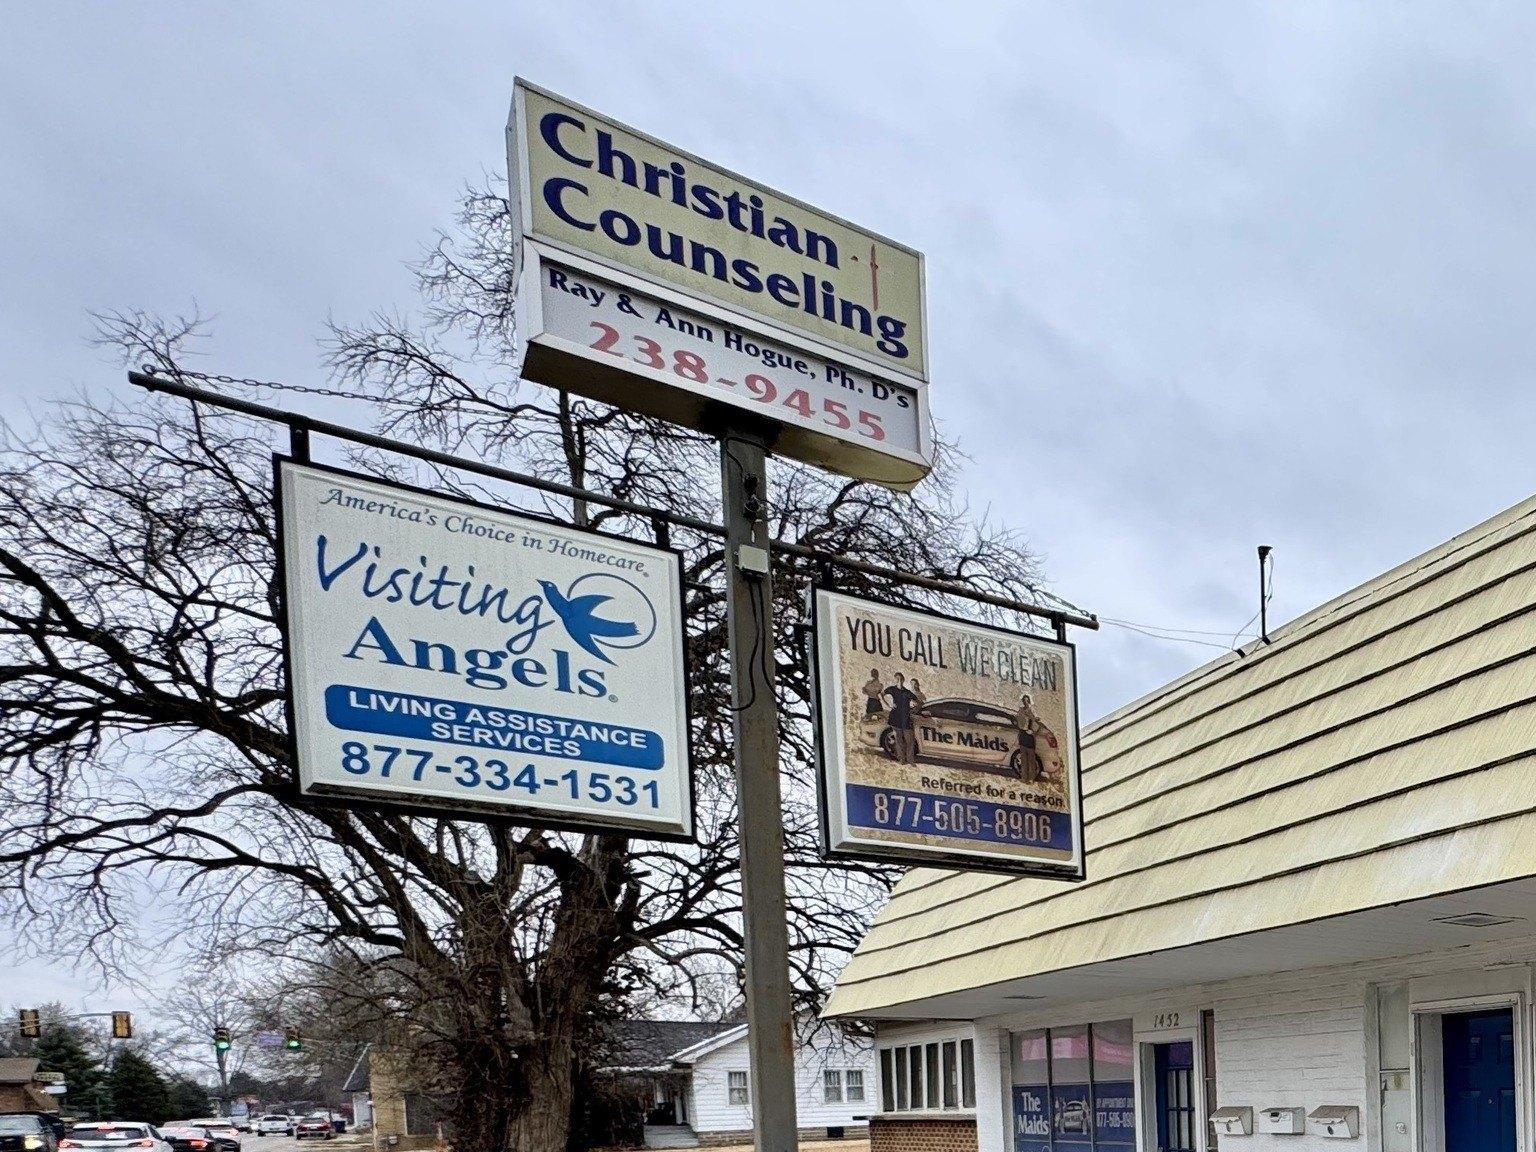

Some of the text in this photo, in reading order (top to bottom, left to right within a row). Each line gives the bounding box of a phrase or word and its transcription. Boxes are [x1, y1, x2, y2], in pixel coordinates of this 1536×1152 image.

[540, 112, 840, 270] Christian
[543, 177, 909, 359] Counseling
[549, 268, 909, 408] Ray & Ann Hogue, Ph. D's
[589, 321, 886, 442] 238-9455
[318, 489, 437, 526] America's
[444, 516, 515, 544] Choice
[521, 532, 543, 550] in
[317, 535, 555, 654] Visiting
[846, 615, 1057, 691] YOU CALL WE CLEAN
[348, 691, 648, 749] LIVING ASSISTANCE
[431, 722, 581, 757] SERVICES
[920, 724, 1009, 752] The Maids
[342, 741, 660, 808] 877-334-1531
[921, 776, 981, 796] Referred
[985, 784, 1005, 798] for
[1009, 790, 1016, 800] a
[874, 792, 1051, 843] 877-505-8906
[1153, 1012, 1179, 1028] 1452
[1018, 1114, 1050, 1135] Maids
[1022, 1092, 1041, 1112] The
